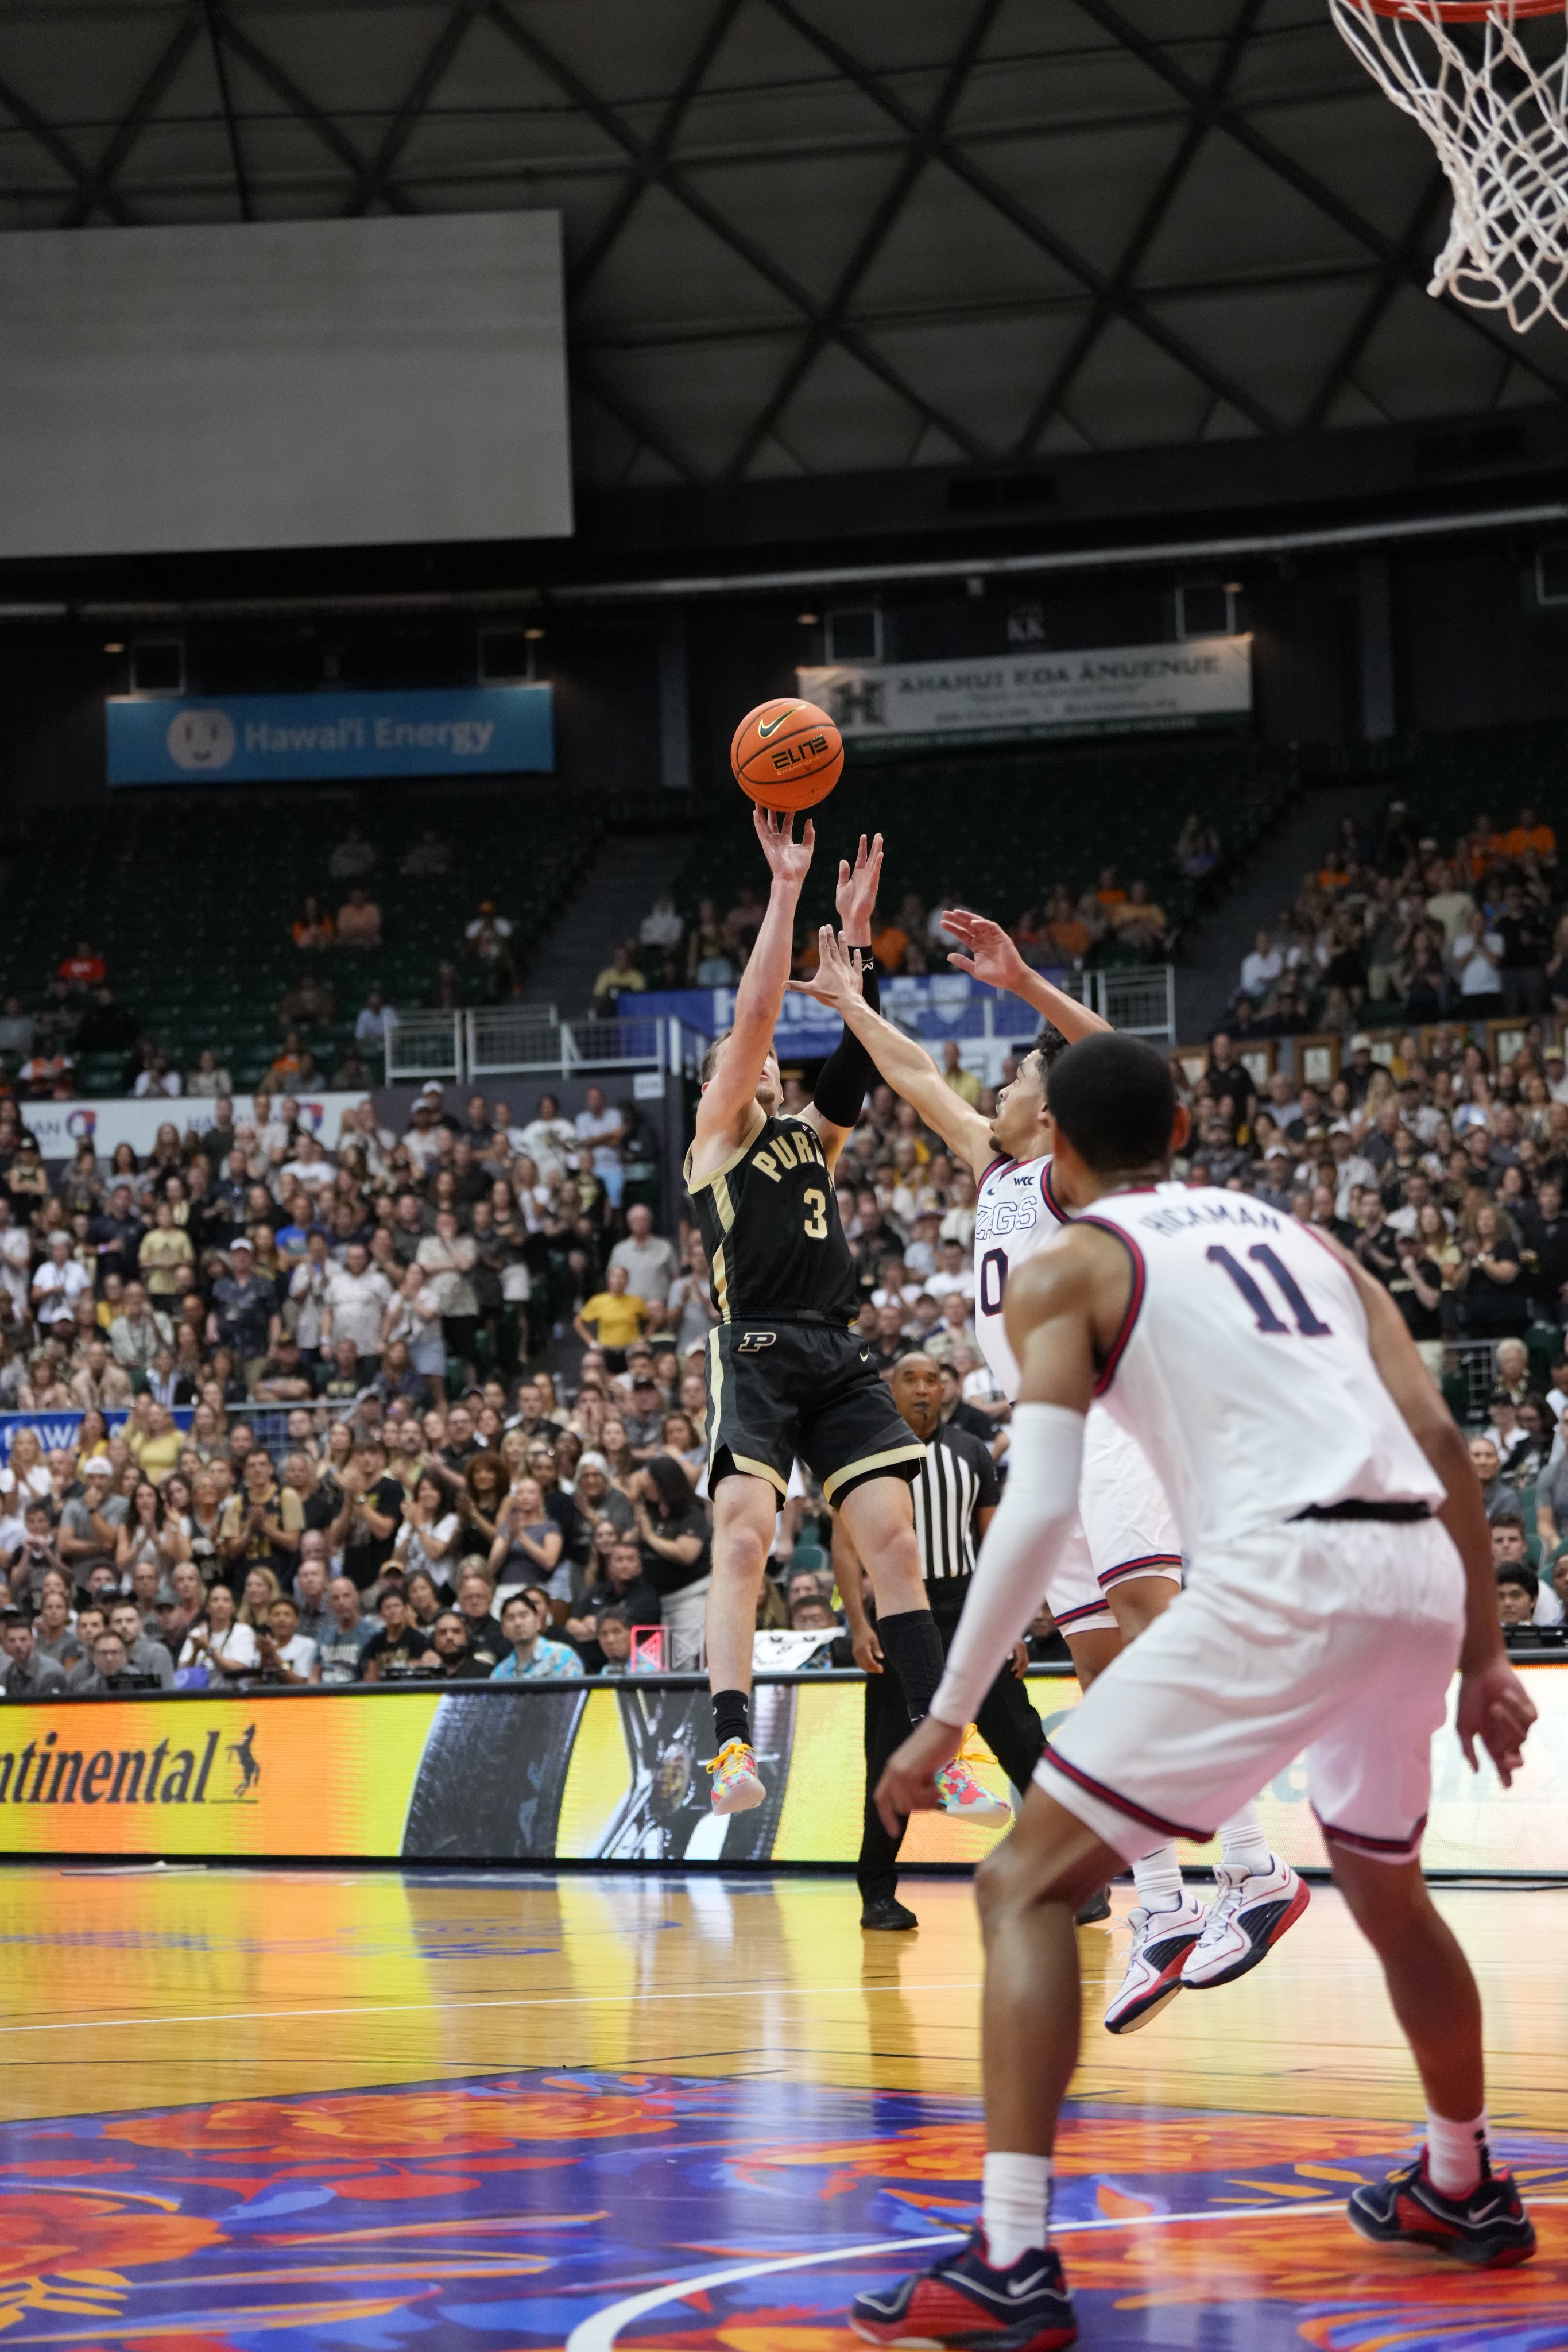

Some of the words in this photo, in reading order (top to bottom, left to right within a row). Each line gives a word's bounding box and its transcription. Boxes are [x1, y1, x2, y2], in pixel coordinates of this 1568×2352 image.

[374, 715, 495, 755] Energy
[772, 734, 828, 770] ELITE
[752, 1131, 827, 1184] PUR
[804, 1187, 828, 1240] 3
[981, 1247, 1008, 1317] 0
[1206, 1243, 1332, 1337] 11
[737, 1332, 777, 1353] P
